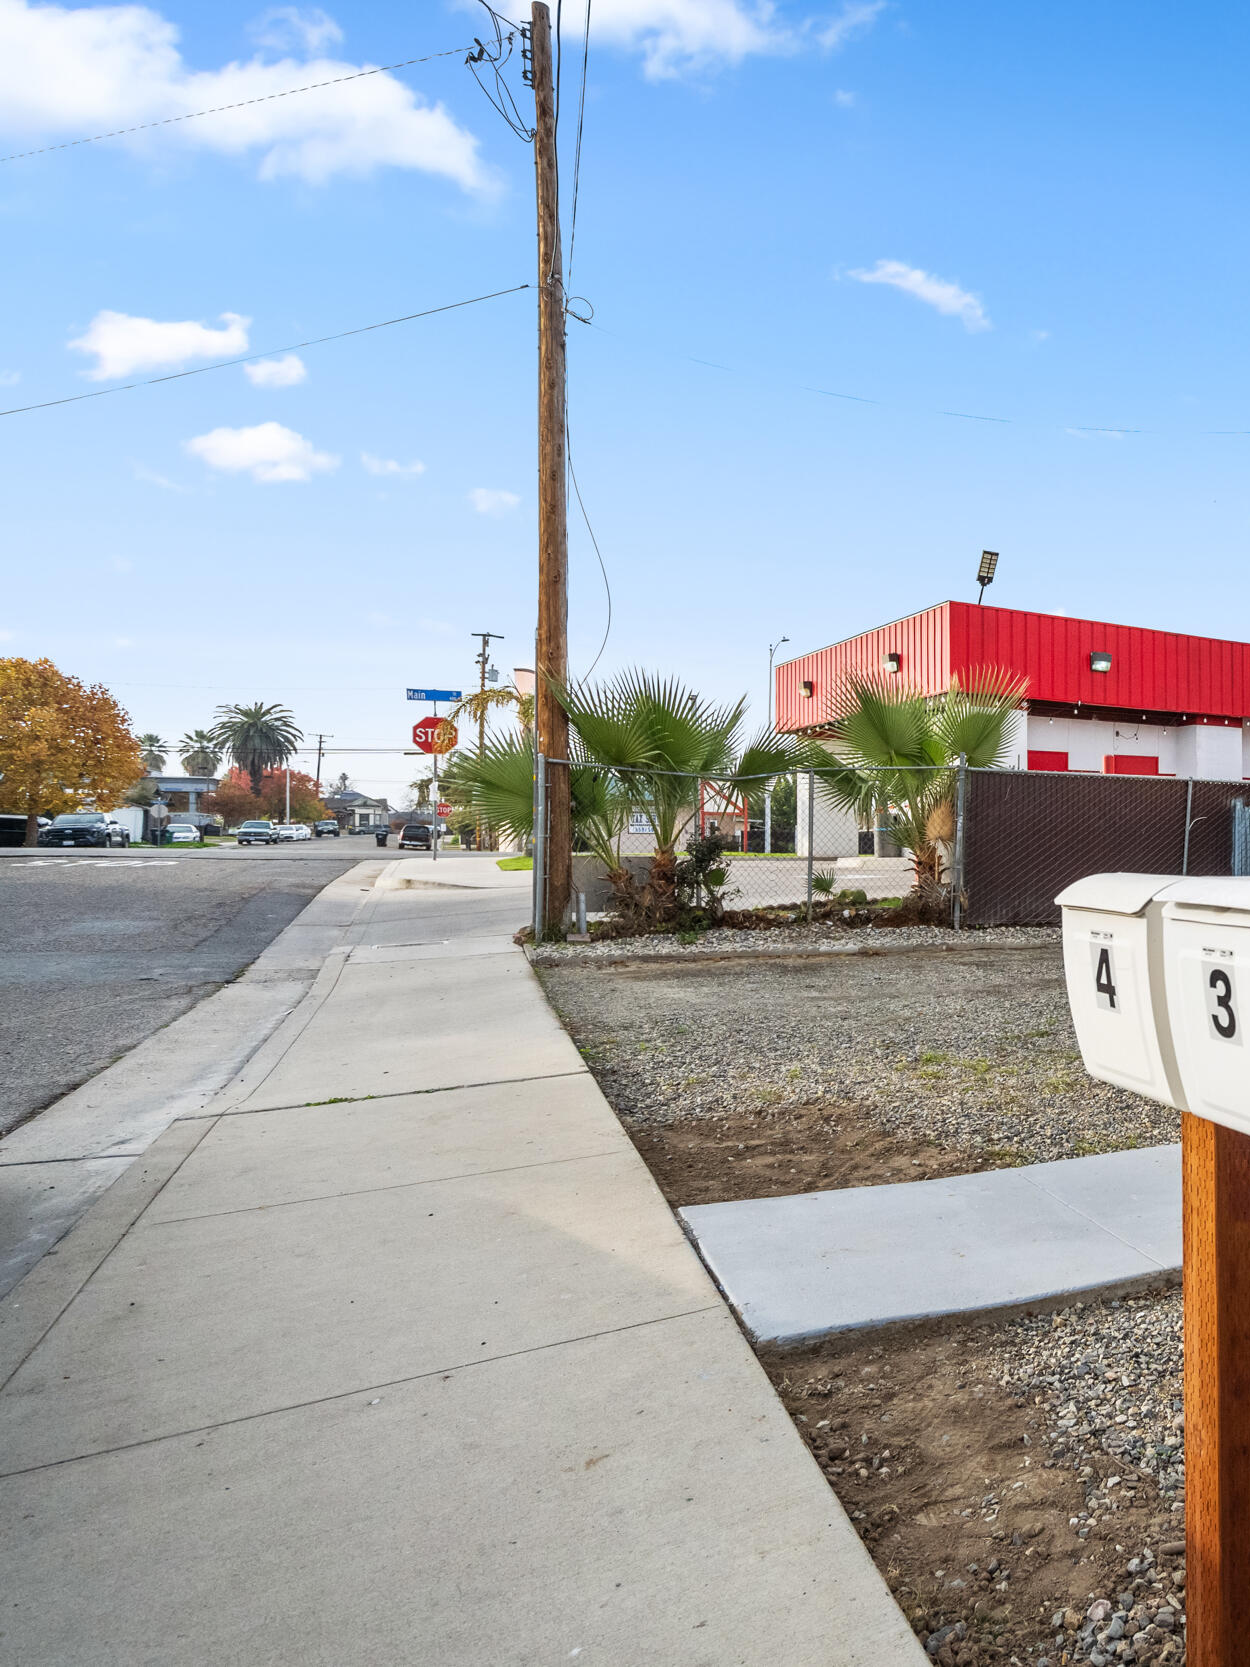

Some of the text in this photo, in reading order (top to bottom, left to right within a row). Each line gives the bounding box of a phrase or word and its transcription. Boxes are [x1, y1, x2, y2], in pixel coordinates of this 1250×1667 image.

[407, 690, 426, 699] Main
[1096, 948, 1117, 1009] 4
[1209, 969, 1236, 1039] 3
